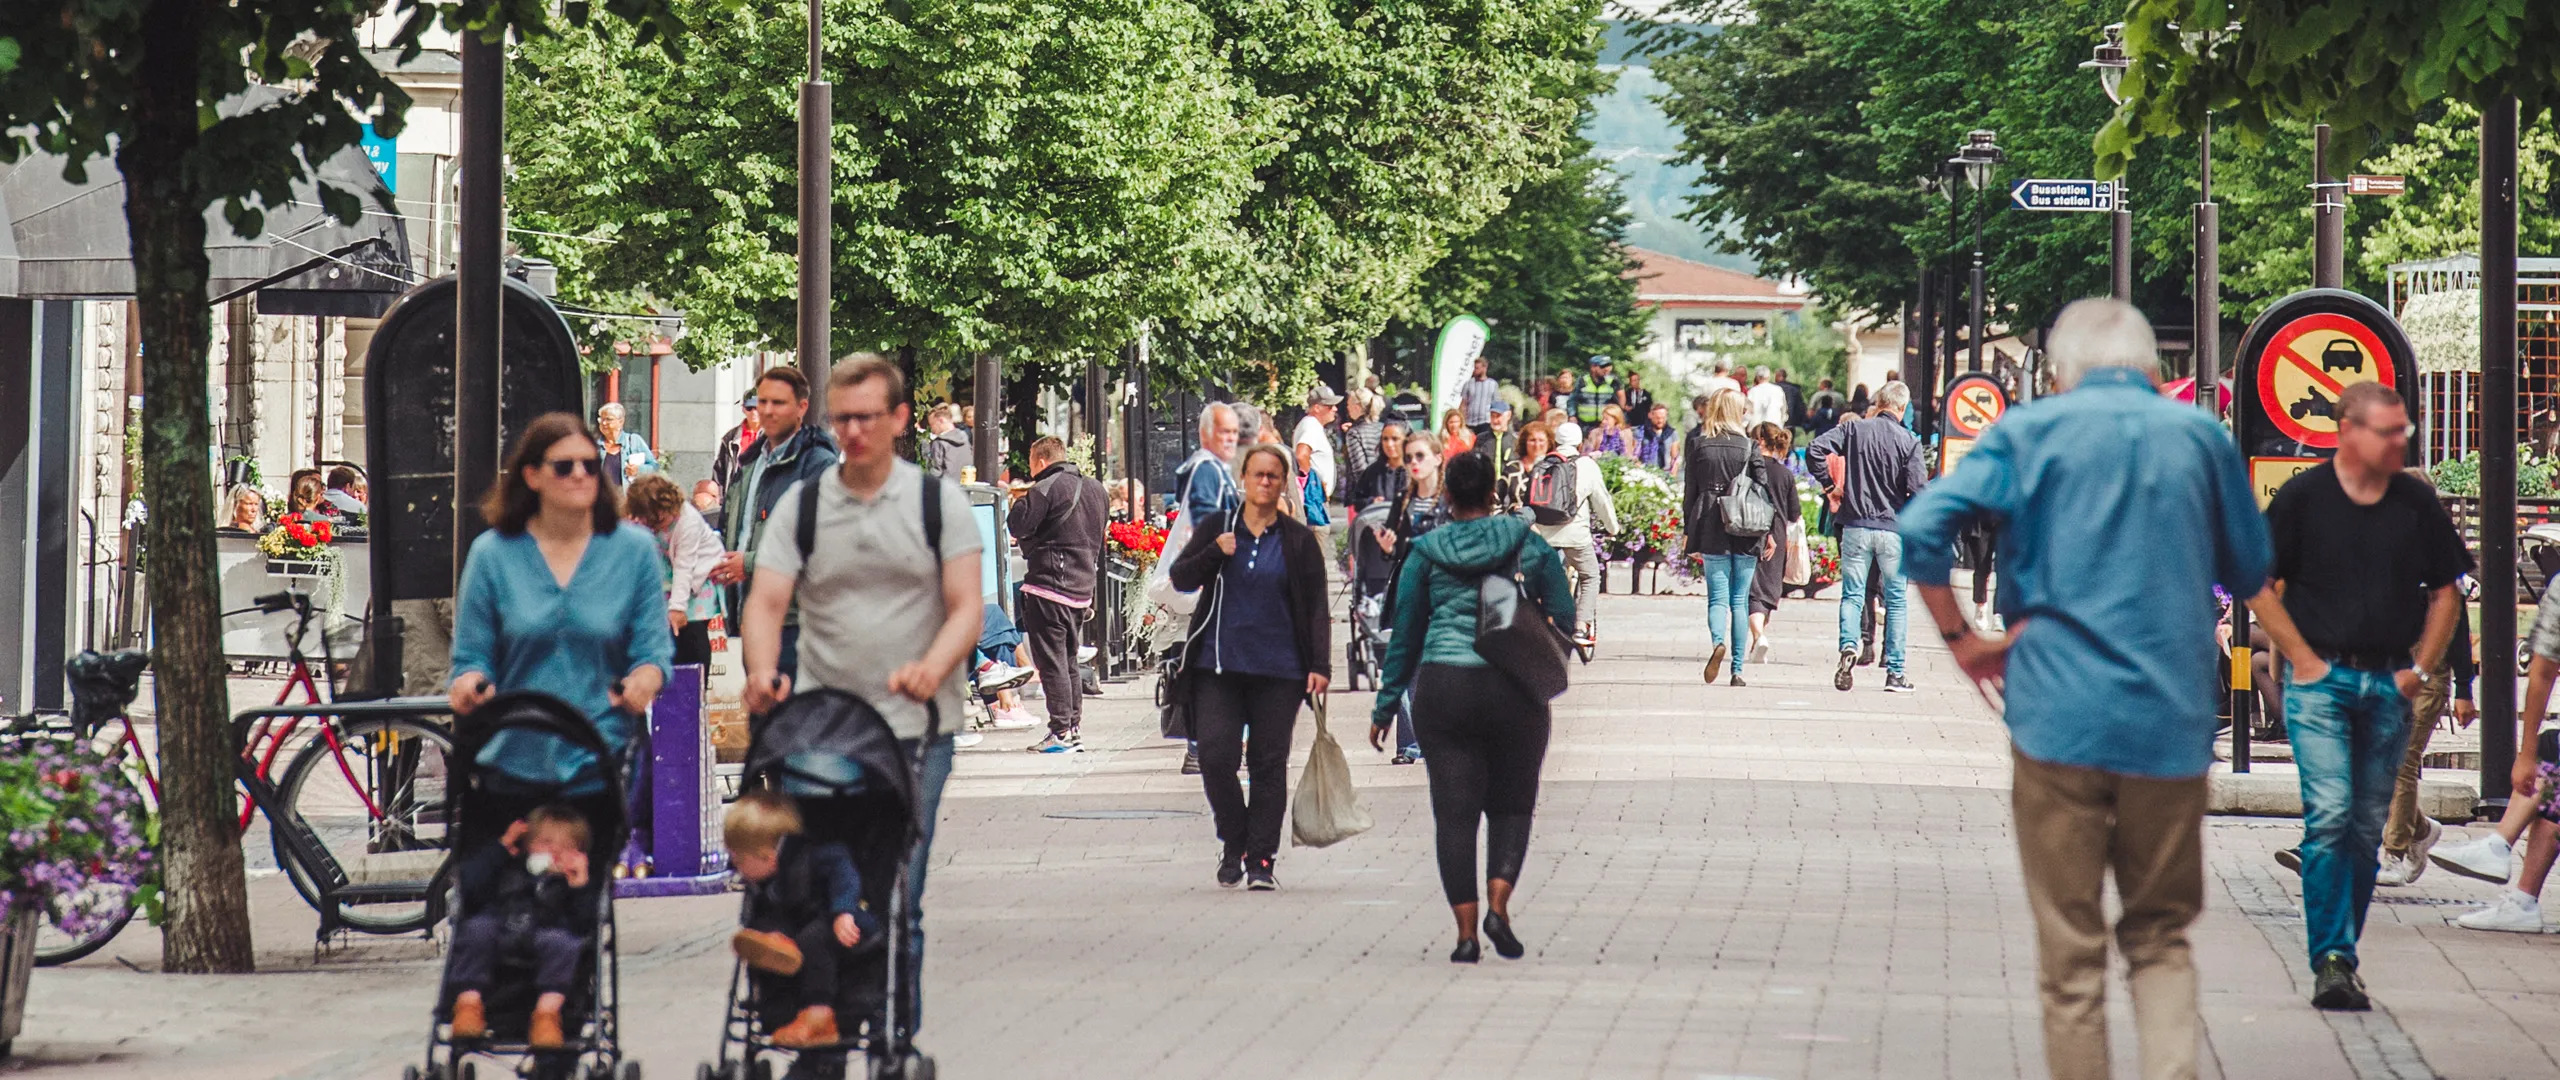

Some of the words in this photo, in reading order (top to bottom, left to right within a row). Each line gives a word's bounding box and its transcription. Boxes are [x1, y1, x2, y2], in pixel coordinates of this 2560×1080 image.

[2031, 184, 2087, 195] Busstation
[2031, 195, 2051, 206] Bus
[2053, 196, 2090, 206] station
